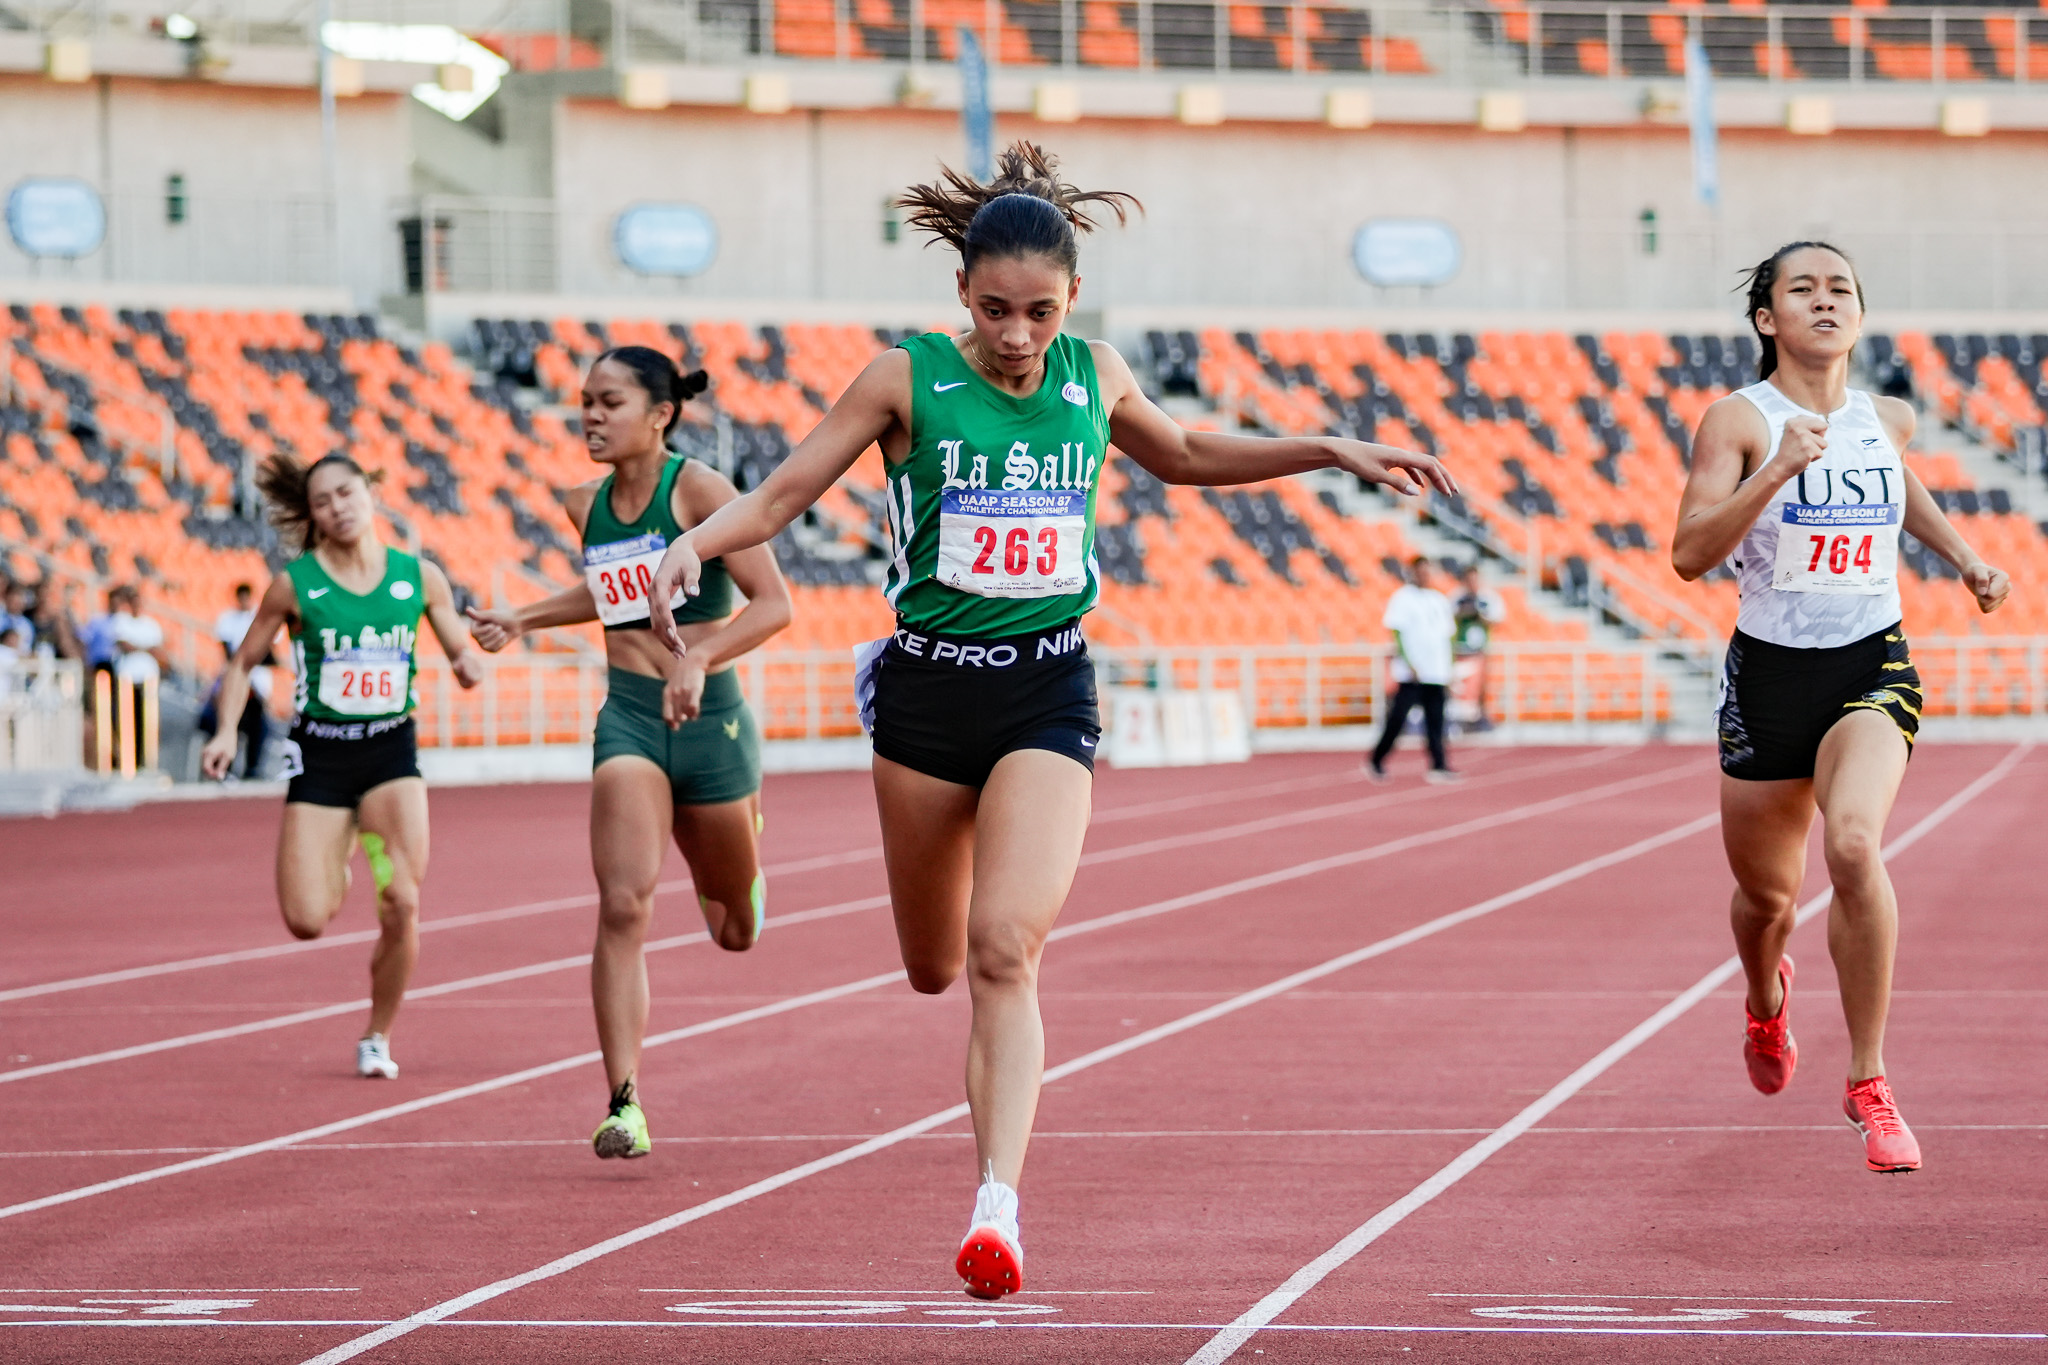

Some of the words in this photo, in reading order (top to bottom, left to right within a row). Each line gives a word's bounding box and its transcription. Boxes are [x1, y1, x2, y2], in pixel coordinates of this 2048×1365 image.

[937, 439, 989, 490] La
[1001, 440, 1096, 491] Salle
[958, 494, 998, 506] UAAP
[1001, 496, 1055, 508] SEASON
[1056, 495, 1072, 507] 87
[1797, 467, 1894, 506] UST
[959, 505, 1006, 515] ATHLETICS
[1007, 505, 1069, 515] CHAMPIONSHIPS
[1796, 508, 1830, 518] UAAP
[1830, 508, 1876, 518] SEASON
[1876, 507, 1889, 518] 87
[1796, 517, 1834, 525] ATHLETICS
[1835, 517, 1887, 525] CHAMPIONSHIPS
[971, 526, 1059, 576] 263
[1807, 534, 1873, 575] 764
[600, 563, 652, 605] 380
[893, 627, 929, 657] KE
[931, 641, 1018, 668] PRO
[1035, 622, 1083, 660] NIK
[342, 670, 392, 698] 266
[306, 719, 366, 740] NIKE
